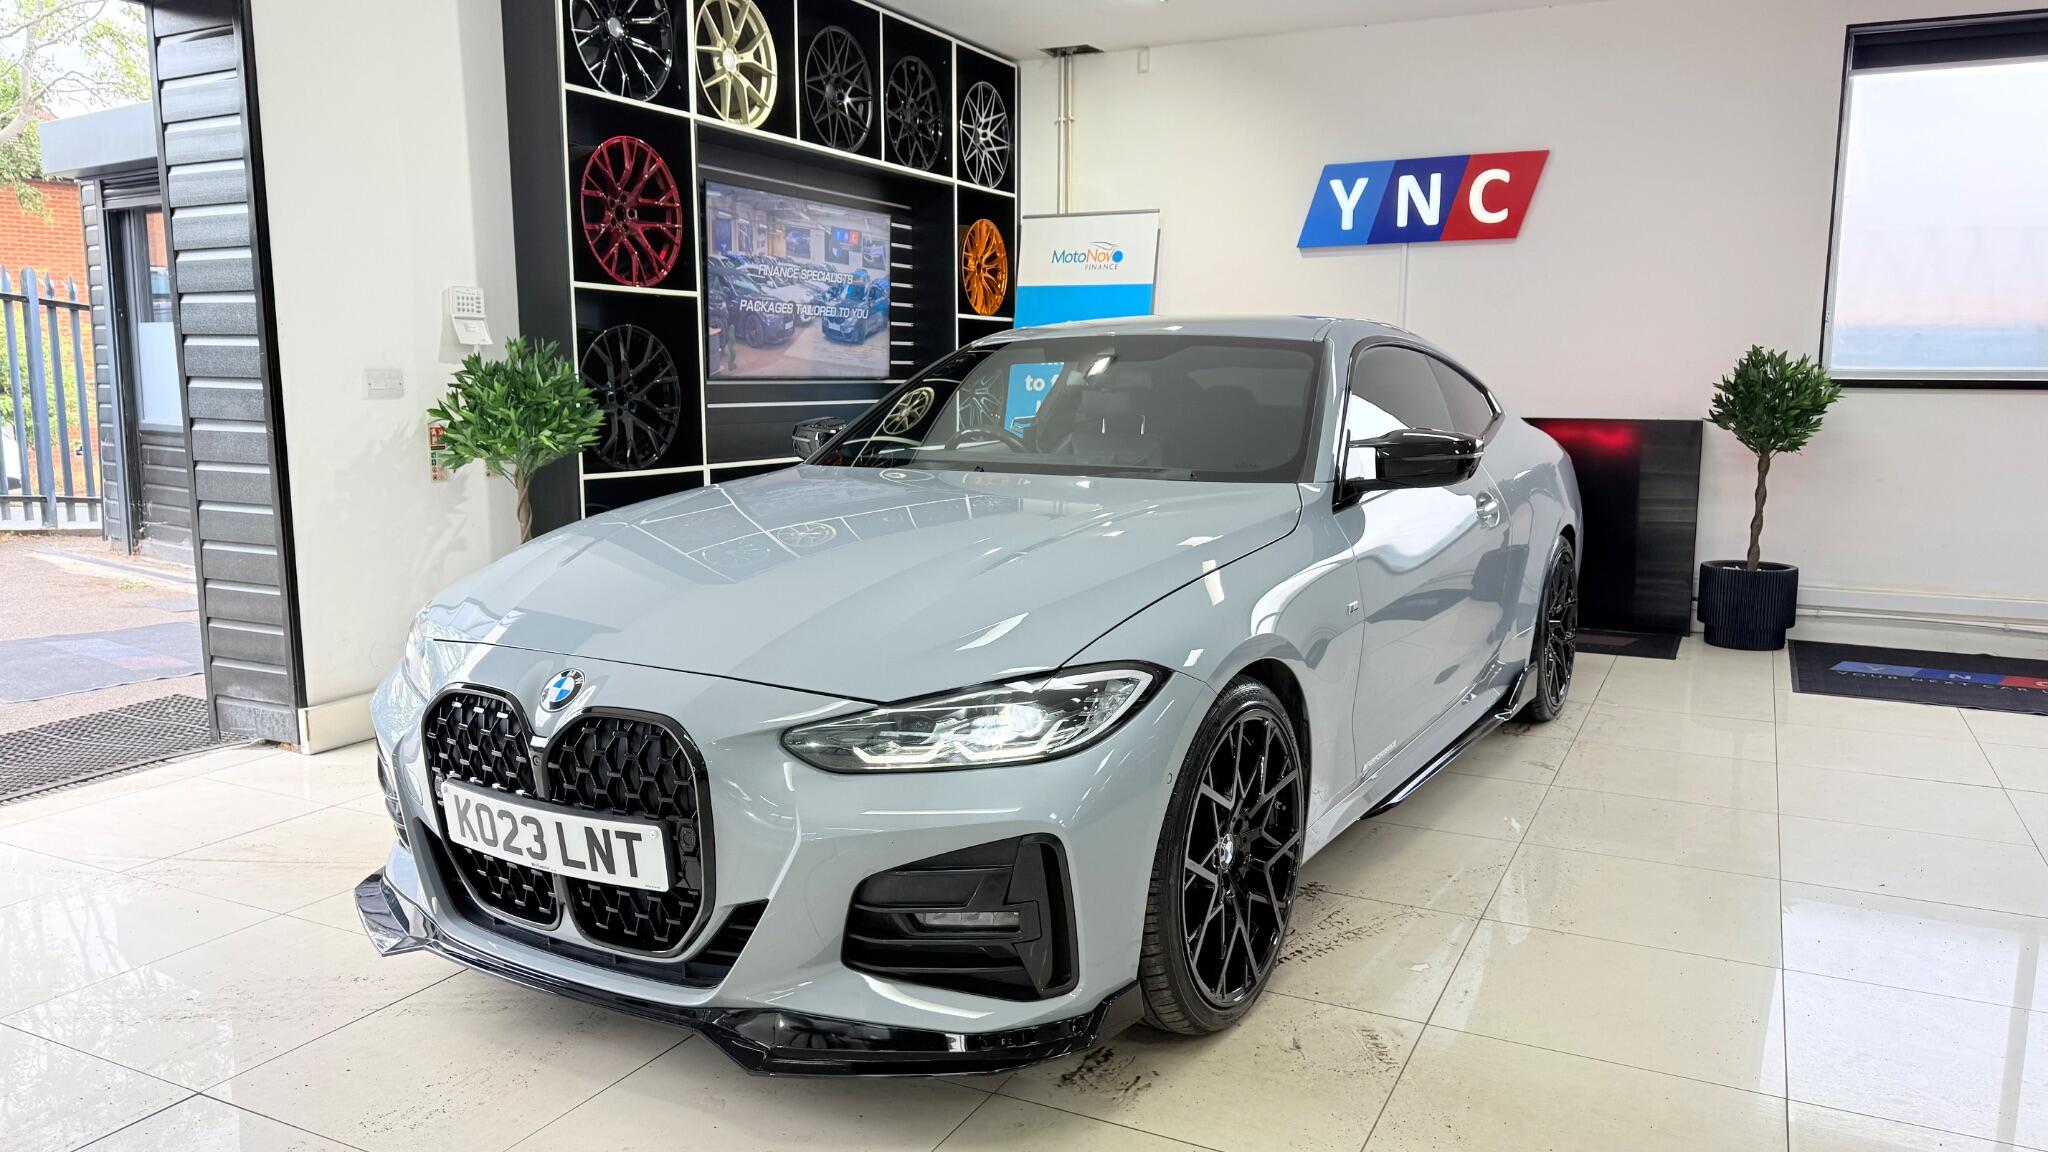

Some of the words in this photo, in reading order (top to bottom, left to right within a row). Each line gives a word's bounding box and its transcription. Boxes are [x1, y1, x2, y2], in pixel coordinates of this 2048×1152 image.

[1329, 168, 1510, 230] YNC
[758, 264, 799, 279] FINANCE
[800, 269, 854, 284] SPECIALISTS
[1084, 263, 1119, 271] FINANCE
[740, 299, 793, 314] PACKAGES
[796, 304, 837, 317] TAILORED
[839, 307, 850, 318] TO
[852, 308, 869, 319] YOU
[1025, 374, 1046, 392] to
[454, 794, 548, 861] KO23
[555, 821, 643, 878] LNT
